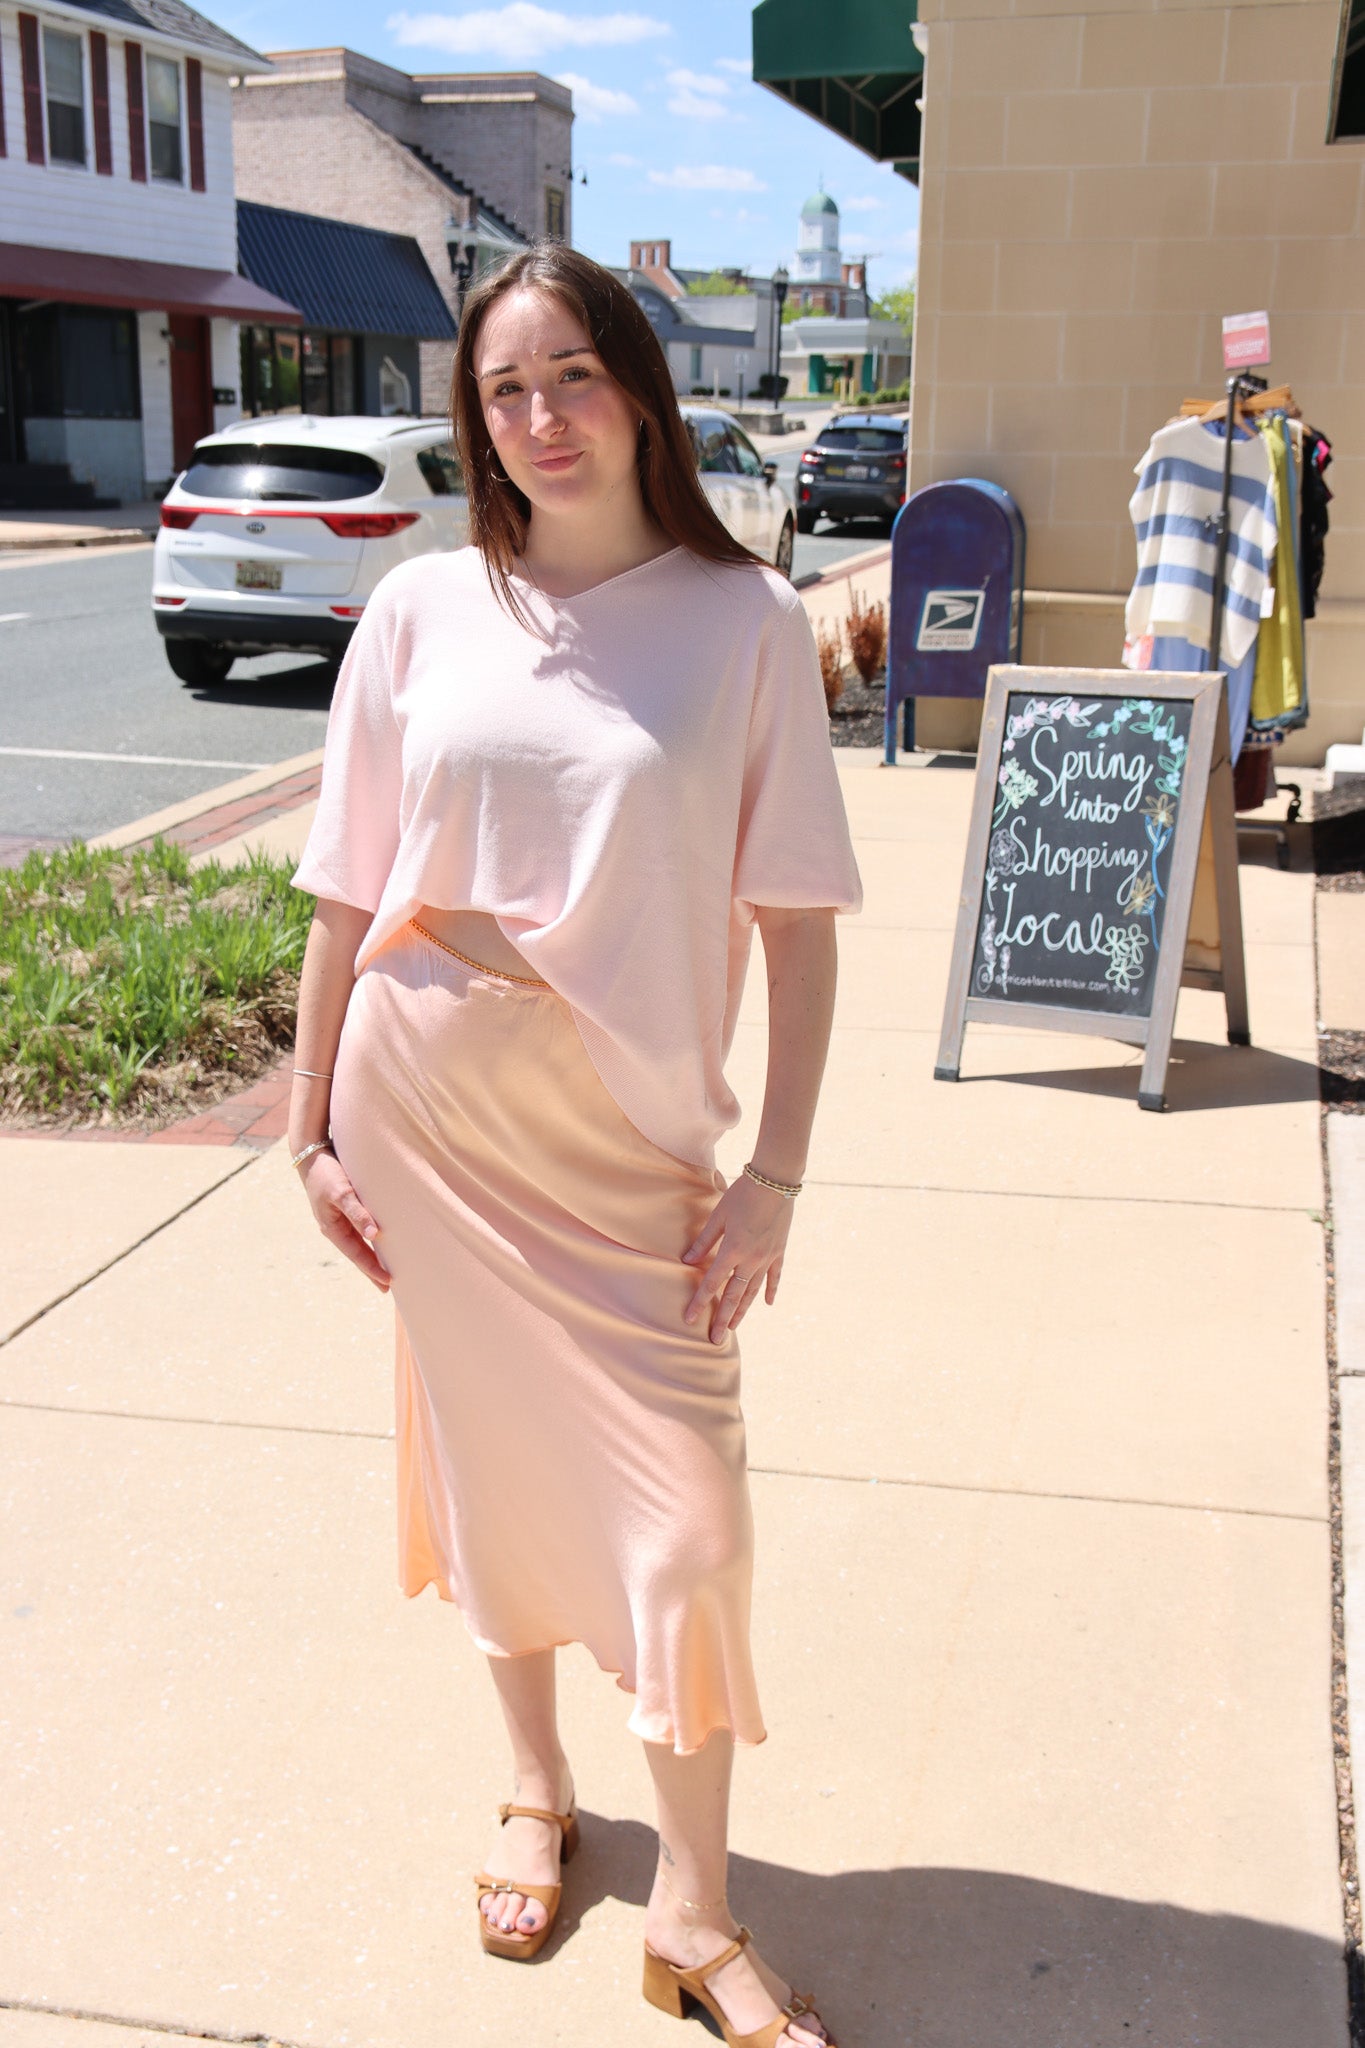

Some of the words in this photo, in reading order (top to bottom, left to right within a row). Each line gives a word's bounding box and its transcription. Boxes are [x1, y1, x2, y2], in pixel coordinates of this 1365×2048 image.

[1031, 726, 1153, 811] Spring
[1064, 791, 1120, 823] into
[1009, 815, 1148, 905] Shopping
[994, 882, 1107, 955] Local
